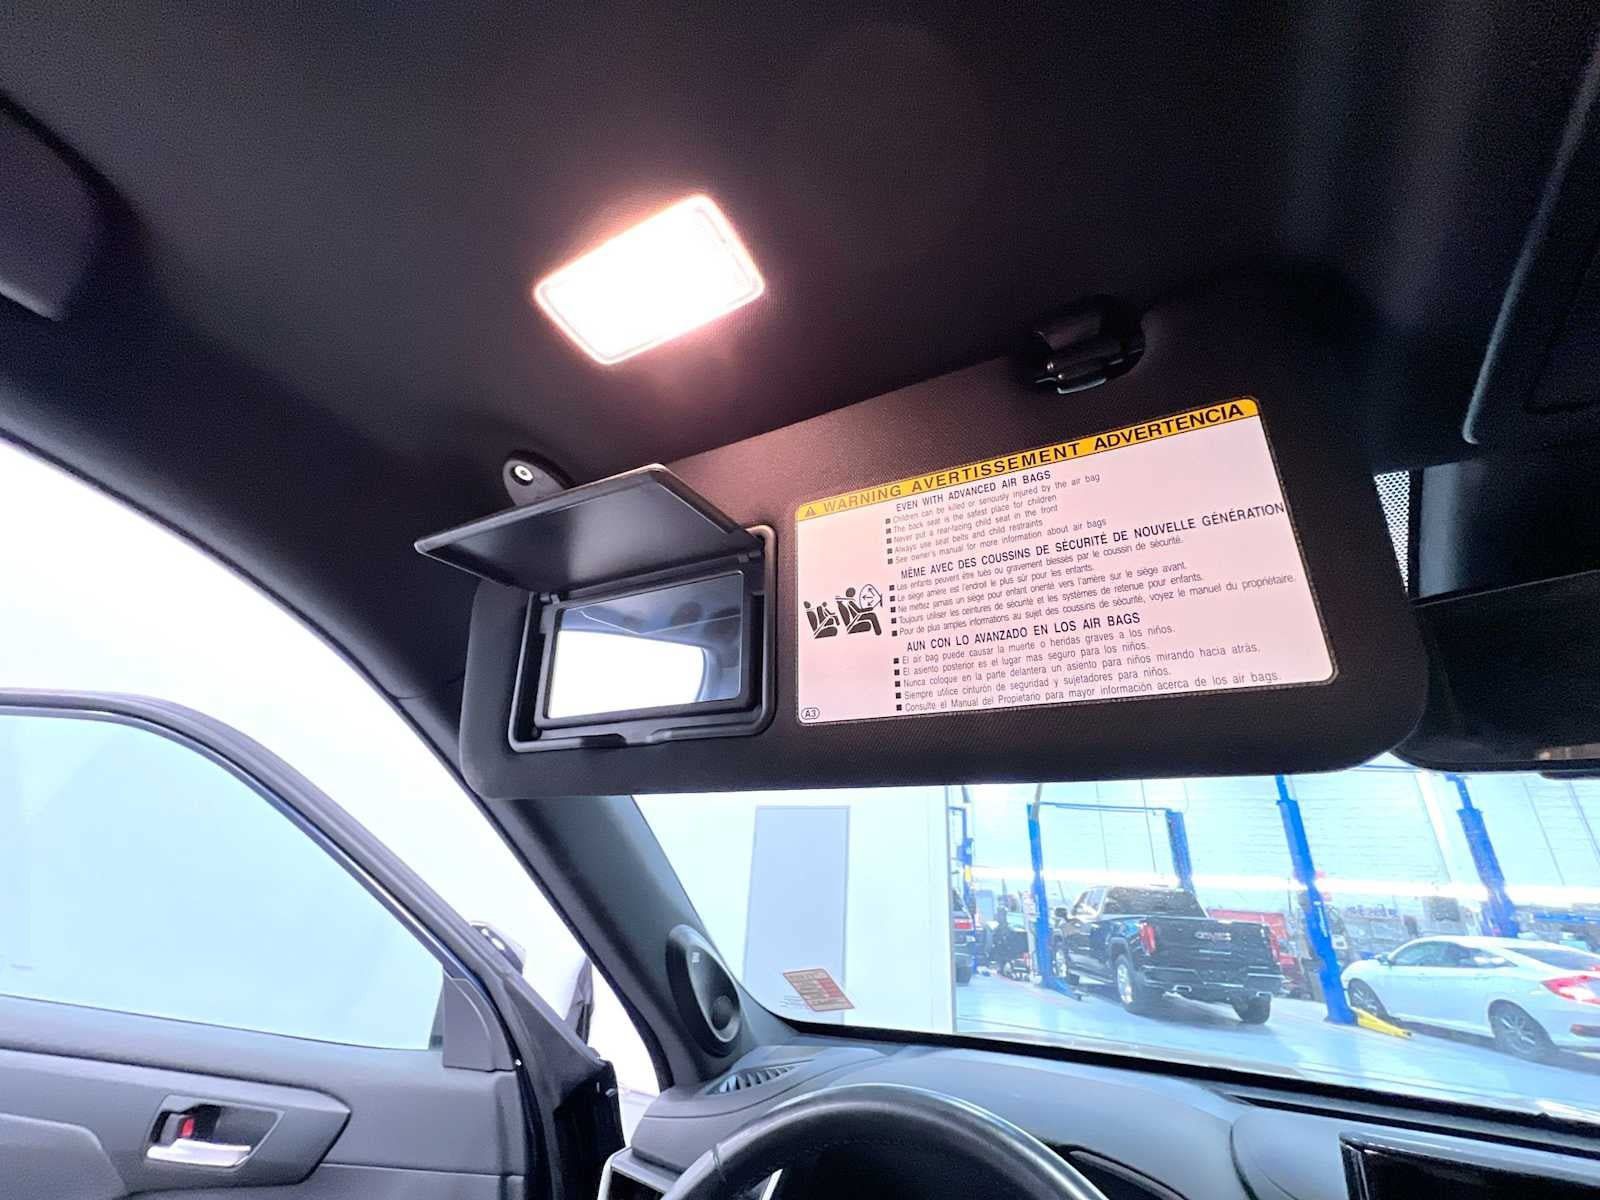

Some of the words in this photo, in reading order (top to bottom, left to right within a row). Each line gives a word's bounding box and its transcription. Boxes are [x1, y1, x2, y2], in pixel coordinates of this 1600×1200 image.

[822, 484, 901, 512] WARNING
[910, 441, 1081, 492] AVERTISSEMENT
[1092, 403, 1243, 449] ADVERTENCIA
[896, 500, 917, 511] EVEN
[921, 494, 942, 505] WITH
[947, 482, 995, 500] ADVANCED
[1000, 478, 1015, 488] AIR
[1022, 470, 1051, 483] BAGS
[1012, 486, 1037, 498] injured
[1041, 484, 1051, 492] by
[1053, 481, 1068, 489] the
[1070, 477, 1082, 485] air
[1084, 474, 1100, 482] bag
[952, 513, 964, 521] the
[966, 507, 988, 518] safest
[990, 504, 1010, 515] place
[1026, 494, 1057, 505] children
[974, 517, 991, 527] child
[994, 513, 1010, 523] seat
[1023, 509, 1037, 517] the
[1040, 504, 1058, 513] front
[929, 562, 954, 573] AVEC
[958, 558, 977, 568] DES
[980, 548, 1031, 564] COUSSINS
[1036, 545, 1049, 555] DE
[1054, 532, 1108, 551] SÉCURITÉ
[1112, 531, 1128, 541] DE
[1133, 519, 1196, 538] NOUVELLE
[1200, 503, 1284, 526] GÉNÉRATION
[938, 544, 963, 555] manual
[978, 539, 999, 547] more
[1001, 531, 1042, 543] information
[1046, 525, 1067, 535] about
[1071, 522, 1083, 530] air
[1086, 519, 1106, 528] bags
[971, 529, 985, 538] and
[987, 525, 1005, 535] child
[1008, 519, 1043, 531] restraints
[1005, 559, 1042, 574] gravement
[1076, 553, 1090, 562] par
[1101, 545, 1132, 556] coussin
[1134, 542, 1147, 551] de
[986, 591, 1003, 600] pour
[1004, 586, 1025, 596] enfant
[1057, 580, 1075, 588] vers
[993, 602, 1003, 610] de
[1035, 596, 1044, 604] et
[1099, 586, 1111, 594] de
[1113, 583, 1144, 592] retenue
[1146, 579, 1167, 590] pour
[998, 577, 1015, 587] plus
[1030, 572, 1048, 582] pour
[1024, 608, 1042, 619] sujet
[1044, 607, 1059, 615] des
[1061, 602, 1096, 613] coussins
[1098, 600, 1111, 608] de
[1148, 592, 1175, 602] voyez
[1177, 589, 1186, 597] le
[1188, 583, 1222, 596] manuel
[1224, 582, 1238, 591] du
[906, 641, 925, 651] AUN
[929, 637, 951, 648] CON
[955, 635, 969, 645] LO
[973, 627, 1028, 642] AVANZADO
[1033, 625, 1048, 635] EN
[1054, 621, 1077, 632] LOS
[1081, 618, 1100, 629] AIR
[1107, 613, 1140, 626] BAGS
[925, 653, 939, 661] bag
[941, 650, 965, 661] puede
[967, 647, 994, 656] causar
[1007, 641, 1035, 651] muerte
[1083, 633, 1114, 644] graves
[1128, 629, 1143, 637] los
[902, 667, 909, 675] El
[911, 665, 939, 674] asiento
[990, 657, 998, 665] el
[1001, 657, 1022, 666] lugar
[1046, 651, 1076, 660] seguro
[1079, 648, 1100, 658] para
[1103, 645, 1118, 653] los
[903, 679, 926, 687] Nunca
[928, 676, 957, 685] coloque
[974, 672, 982, 680] la
[985, 670, 1006, 681] parte
[1008, 666, 1047, 676] delantera
[1065, 660, 1098, 670] asiento
[1101, 659, 1123, 669] para
[1125, 655, 1152, 664] niños
[1156, 650, 1195, 661] mirando
[1199, 647, 1226, 657] hacia
[940, 700, 947, 708] el
[950, 697, 979, 707] Manual
[981, 696, 994, 704] del
[1044, 692, 1064, 701] para
[1067, 689, 1096, 698] mayor
[1156, 680, 1189, 690] acerca
[1193, 677, 1207, 686] de
[1211, 676, 1228, 685] los
[1231, 674, 1246, 683] air
[1062, 673, 1113, 685] sujetadores
[1116, 671, 1138, 681] para
[805, 710, 816, 718] A3
